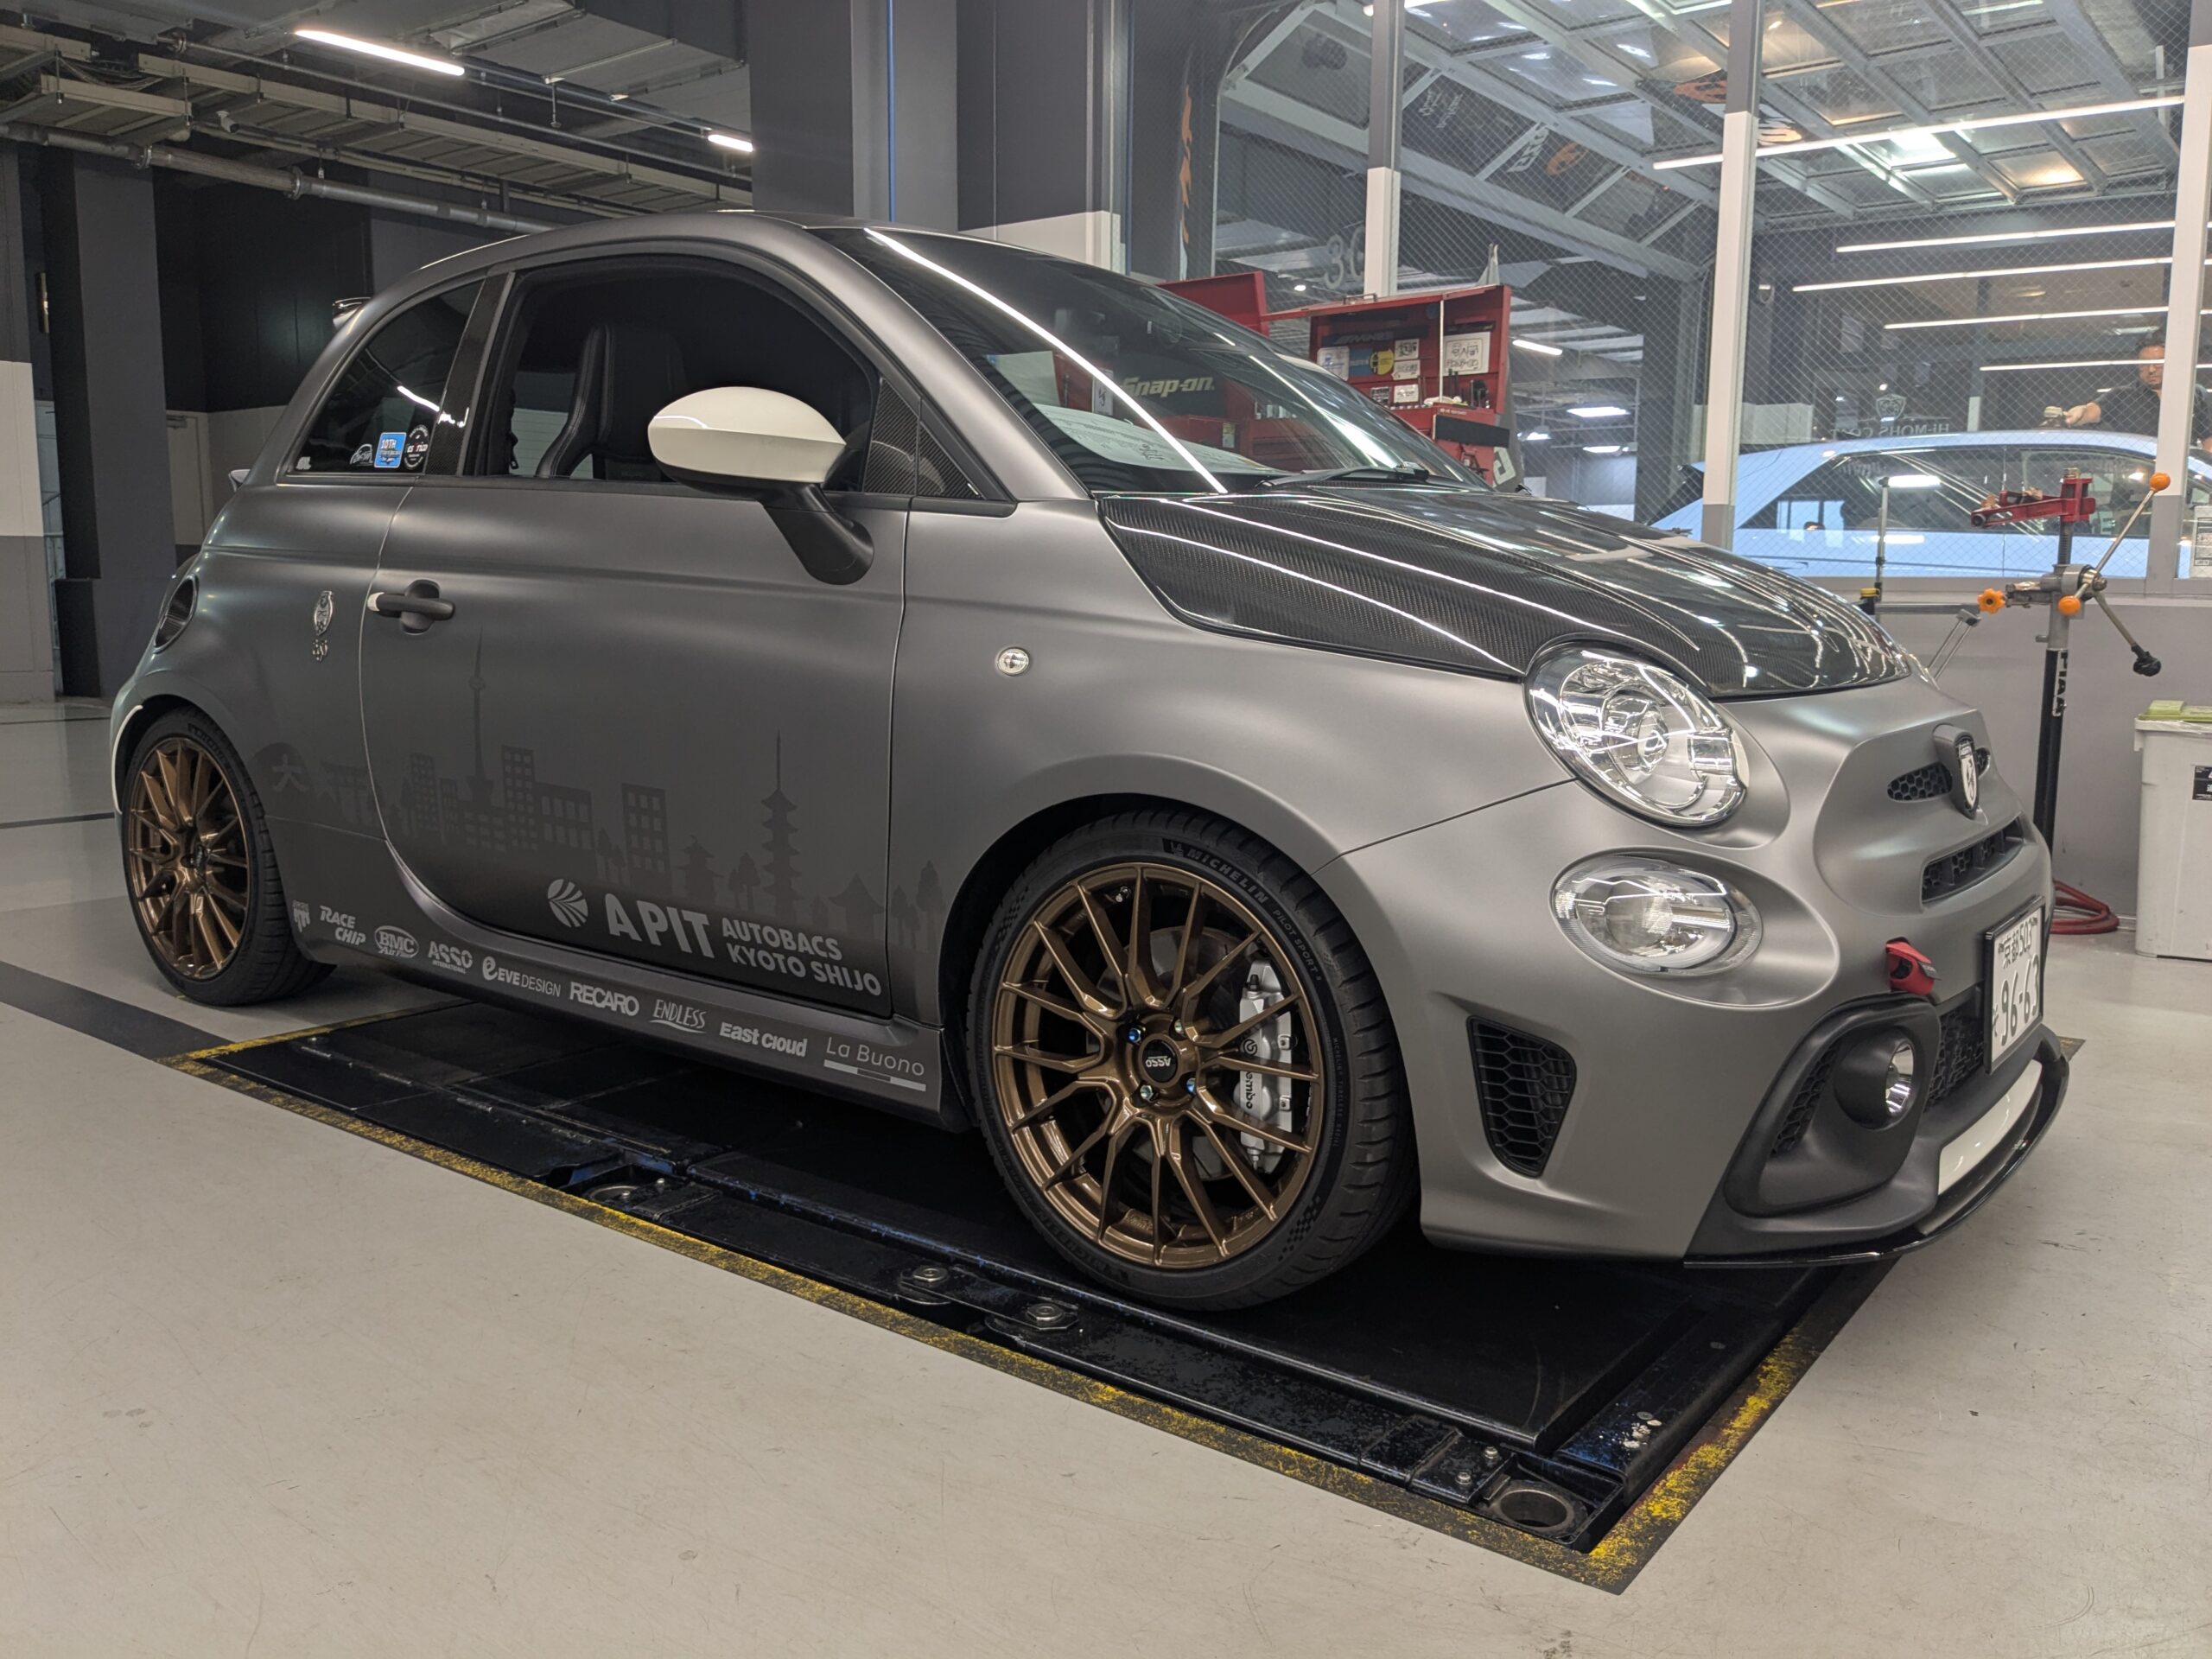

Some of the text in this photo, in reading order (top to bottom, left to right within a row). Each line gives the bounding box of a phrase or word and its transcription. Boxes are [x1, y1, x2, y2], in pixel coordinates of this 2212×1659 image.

[1122, 377, 1214, 397] Snap-on
[1187, 849, 1269, 905] MICHELIN
[319, 905, 356, 929] RACE
[334, 926, 366, 946] CHIP
[378, 931, 415, 953] BMC
[721, 917, 842, 961] AUTOBACS
[1272, 909, 1296, 938] PILOT
[1294, 938, 1319, 972] SPORT
[428, 940, 474, 969] ASSO
[726, 943, 882, 997] KYOTO SHIJO
[521, 976, 561, 997] DESIGN
[569, 981, 639, 1017] RECARO
[652, 999, 706, 1030] ENDLESS
[719, 1022, 760, 1046] East
[826, 1037, 925, 1077] La Buono
[1245, 1071, 1256, 1109] embo
